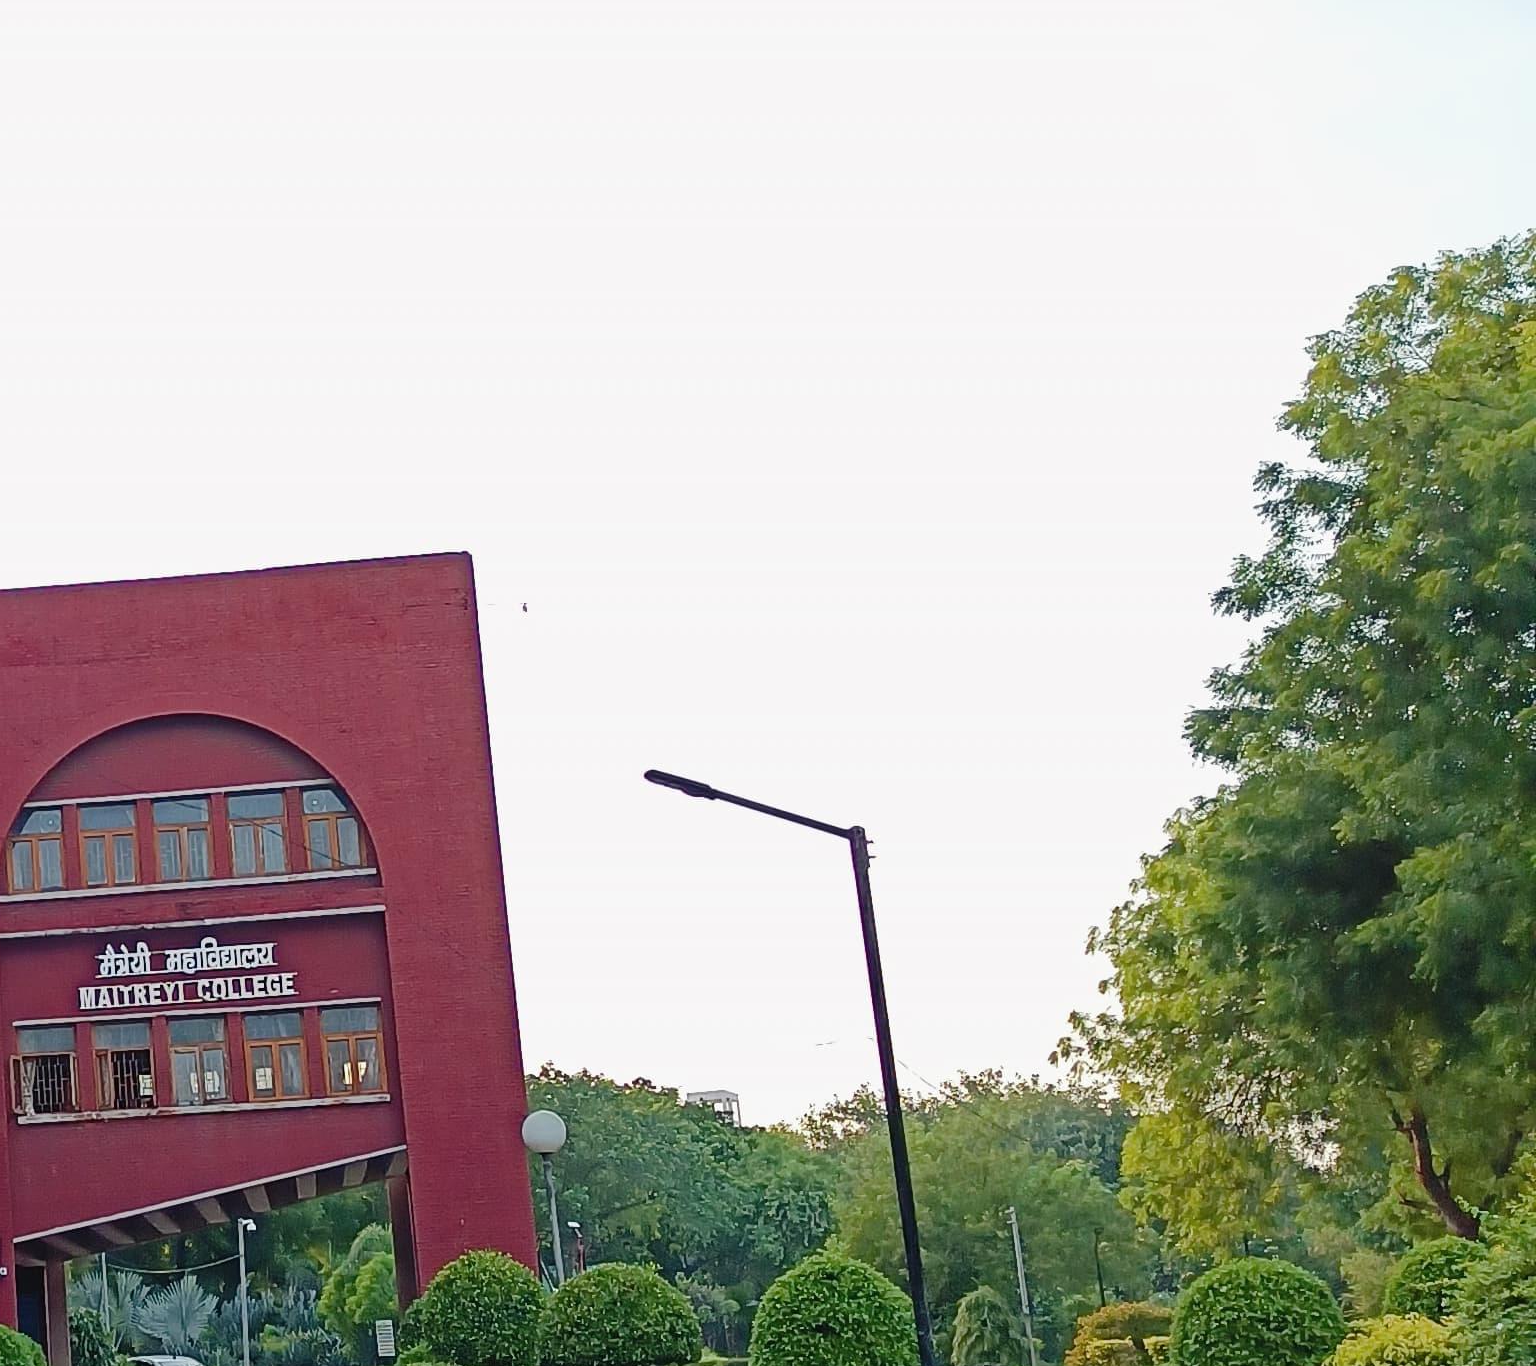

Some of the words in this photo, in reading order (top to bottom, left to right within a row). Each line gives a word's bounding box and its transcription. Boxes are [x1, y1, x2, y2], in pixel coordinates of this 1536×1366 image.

[98, 942, 151, 977] मैत्रेयी
[165, 937, 276, 973] महाविद्यालय
[78, 980, 185, 1009] MAITREYI
[197, 974, 296, 1002] COLLEGE
